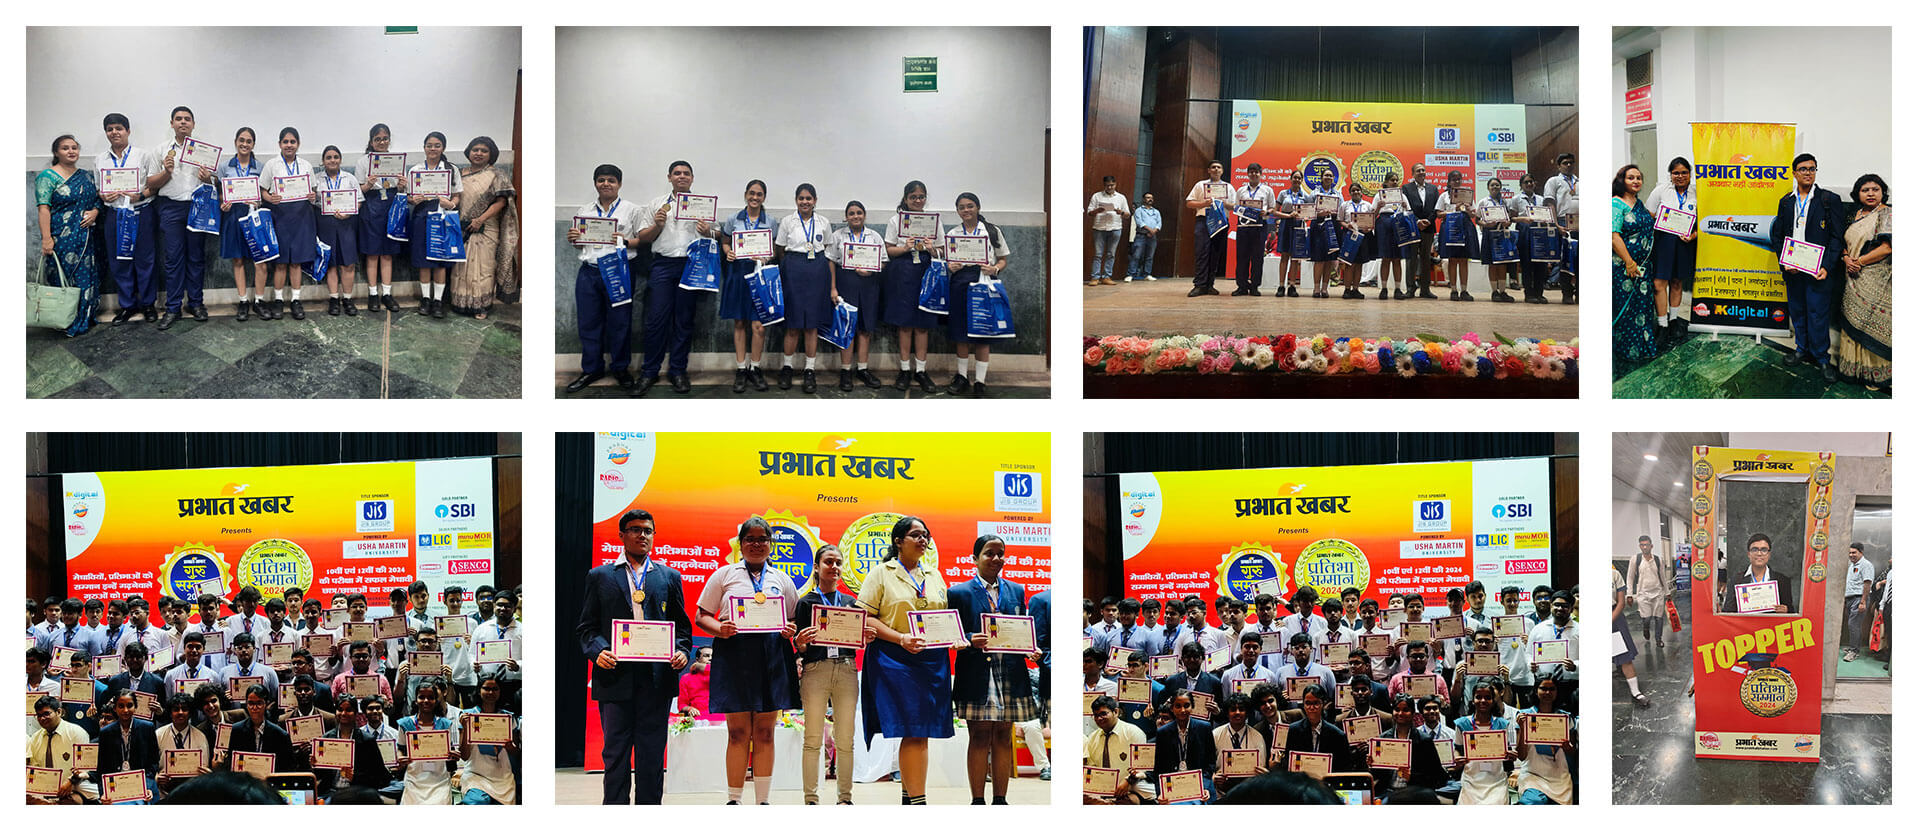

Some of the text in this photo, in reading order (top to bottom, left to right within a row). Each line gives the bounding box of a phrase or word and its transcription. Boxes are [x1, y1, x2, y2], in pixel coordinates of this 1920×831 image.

[1311, 120, 1393, 134] प्रभात खबर
[1498, 132, 1515, 143] SBI
[1695, 164, 1790, 180] प्रभात खबर
[1707, 220, 1758, 233] प्रभात खबर
[758, 450, 914, 480] प्रभात खबर
[1733, 460, 1794, 471] प्रभात खबर
[816, 494, 858, 504] Presents
[177, 495, 294, 518] प्रभात खबर
[450, 504, 475, 518] SBI
[1234, 495, 1351, 518] प्रभात खबर
[1508, 504, 1532, 518] SBI
[996, 526, 1020, 534] USHA
[434, 534, 450, 544] LIC
[1491, 534, 1508, 544] LIC
[378, 542, 406, 550] MARTIN
[654, 544, 720, 557] प्रतिभाओं को
[1436, 542, 1464, 550] MARTIN
[250, 558, 297, 574] प्रतिभा
[458, 561, 488, 570] SENCO
[670, 558, 719, 571] गढ़नेवाले
[1018, 556, 1033, 566] की
[1308, 558, 1354, 574] प्रतिभा
[1514, 561, 1546, 570] SENCO
[183, 565, 207, 579] गुरु
[946, 567, 1034, 578] की सफल
[1240, 565, 1264, 579] गुरु
[250, 574, 297, 586] सम्मान
[1308, 574, 1354, 586] सम्मान
[264, 586, 285, 594] 2024
[1320, 586, 1342, 594] 2024
[1697, 618, 1815, 674] TOPPER
[1750, 681, 1786, 694] प्रतिभा
[1750, 693, 1786, 702] सम्मान
[1736, 738, 1778, 747] प्रभात खबर
